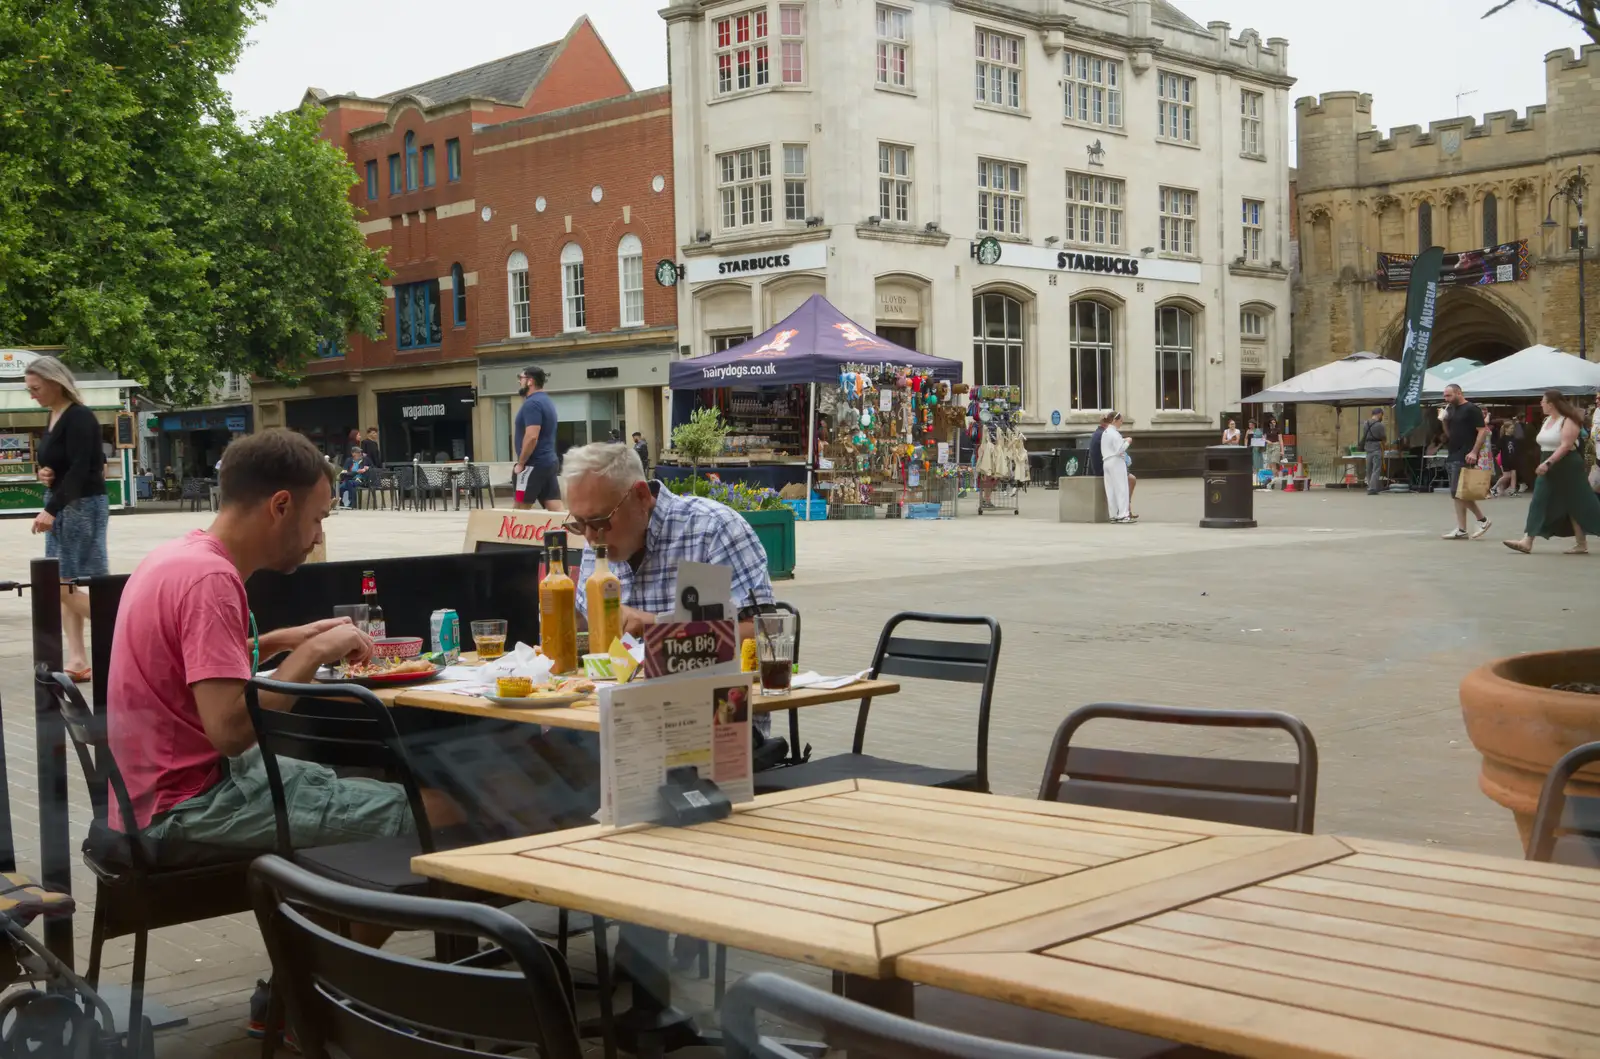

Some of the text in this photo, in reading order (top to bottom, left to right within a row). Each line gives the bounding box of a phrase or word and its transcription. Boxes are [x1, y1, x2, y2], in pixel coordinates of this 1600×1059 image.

[718, 254, 790, 274] STARBUCKS
[1057, 251, 1139, 276] STARBUCKS
[880, 293, 907, 304] LLOYDS
[1419, 281, 1436, 329] MUSEUM
[884, 304, 903, 314] BANK
[1413, 330, 1430, 371] GALORE
[703, 362, 777, 380] hairydogs.co.uk
[402, 403, 445, 420] wagamama
[0, 464, 25, 473] OPEN
[664, 634, 716, 655] The Big
[667, 656, 718, 673] Caesar
